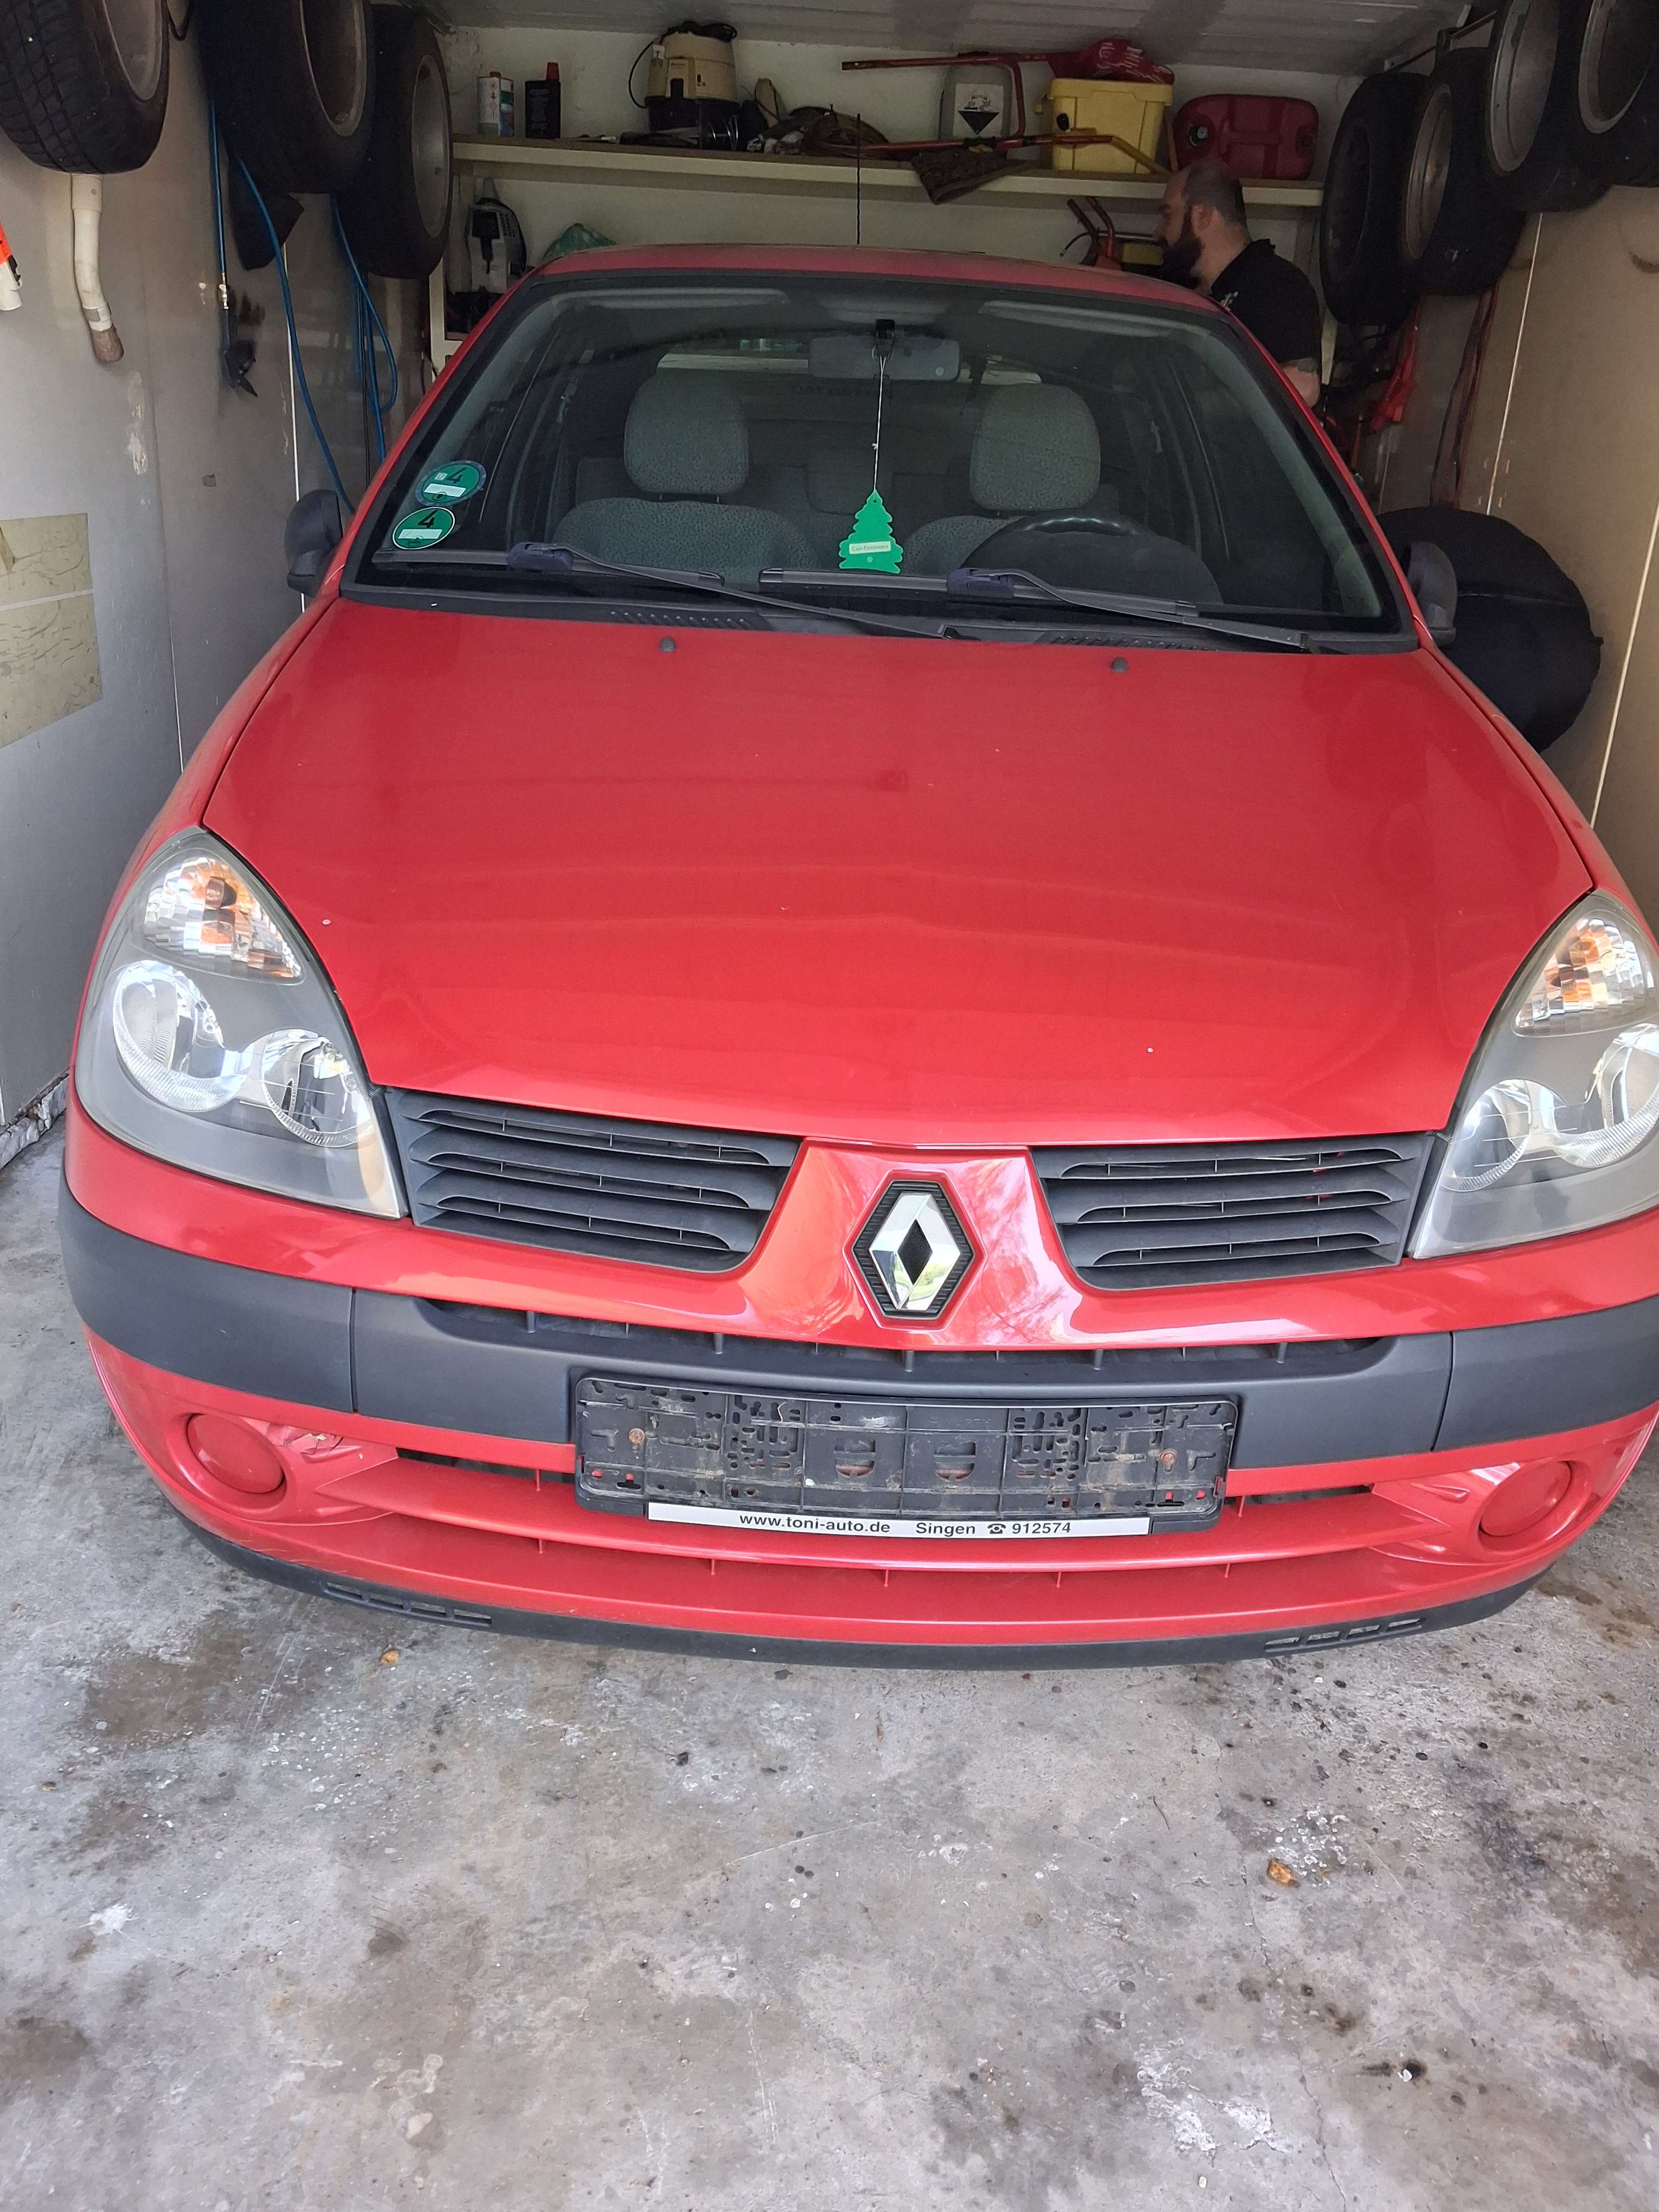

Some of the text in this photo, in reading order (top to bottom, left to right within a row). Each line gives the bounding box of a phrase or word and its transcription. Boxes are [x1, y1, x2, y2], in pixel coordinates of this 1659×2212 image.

[446, 467, 467, 484] 4
[417, 509, 439, 529] 4
[739, 1515, 1071, 1537] www.toni-auto.de Singen 912574
